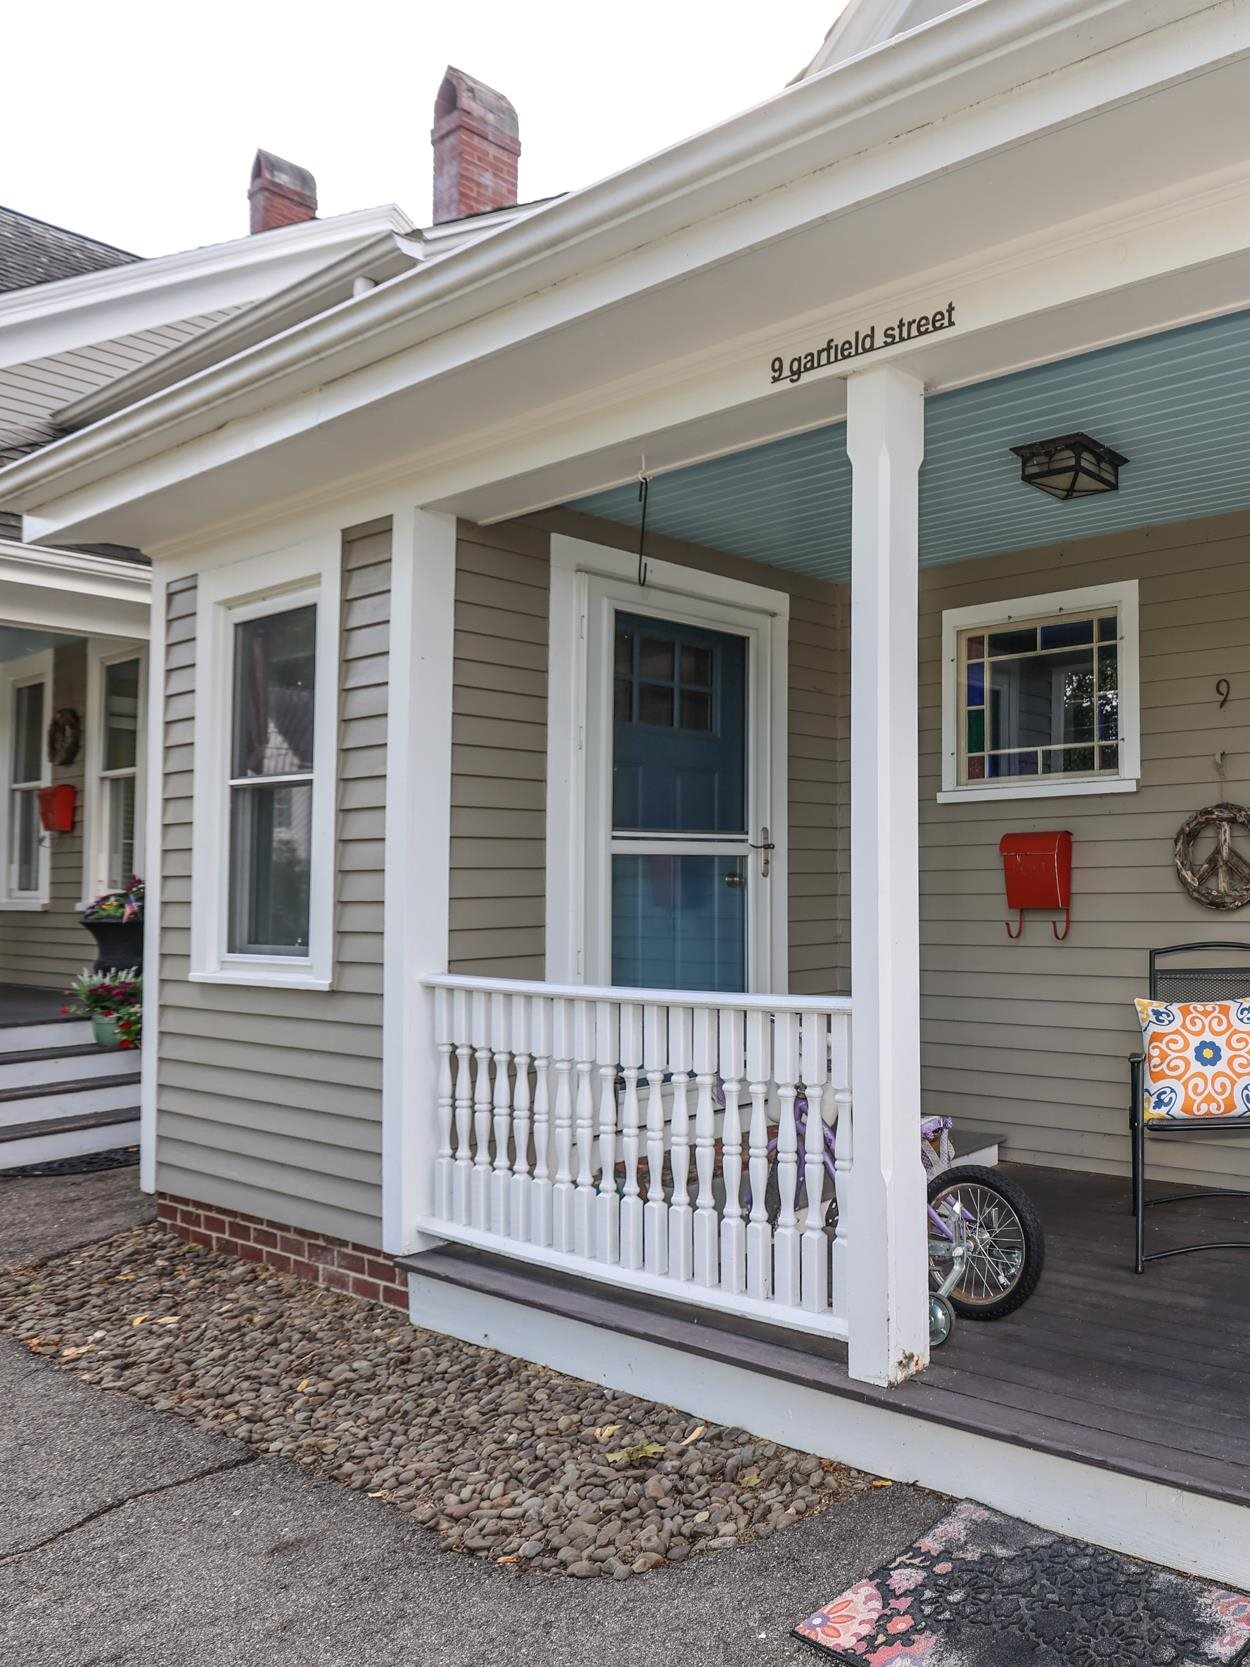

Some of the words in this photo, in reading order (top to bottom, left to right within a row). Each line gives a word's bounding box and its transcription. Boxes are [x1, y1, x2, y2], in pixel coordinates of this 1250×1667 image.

[770, 356, 784, 382] 9
[789, 325, 875, 383] garfield
[883, 301, 955, 347] street
[1215, 678, 1230, 709] 9
